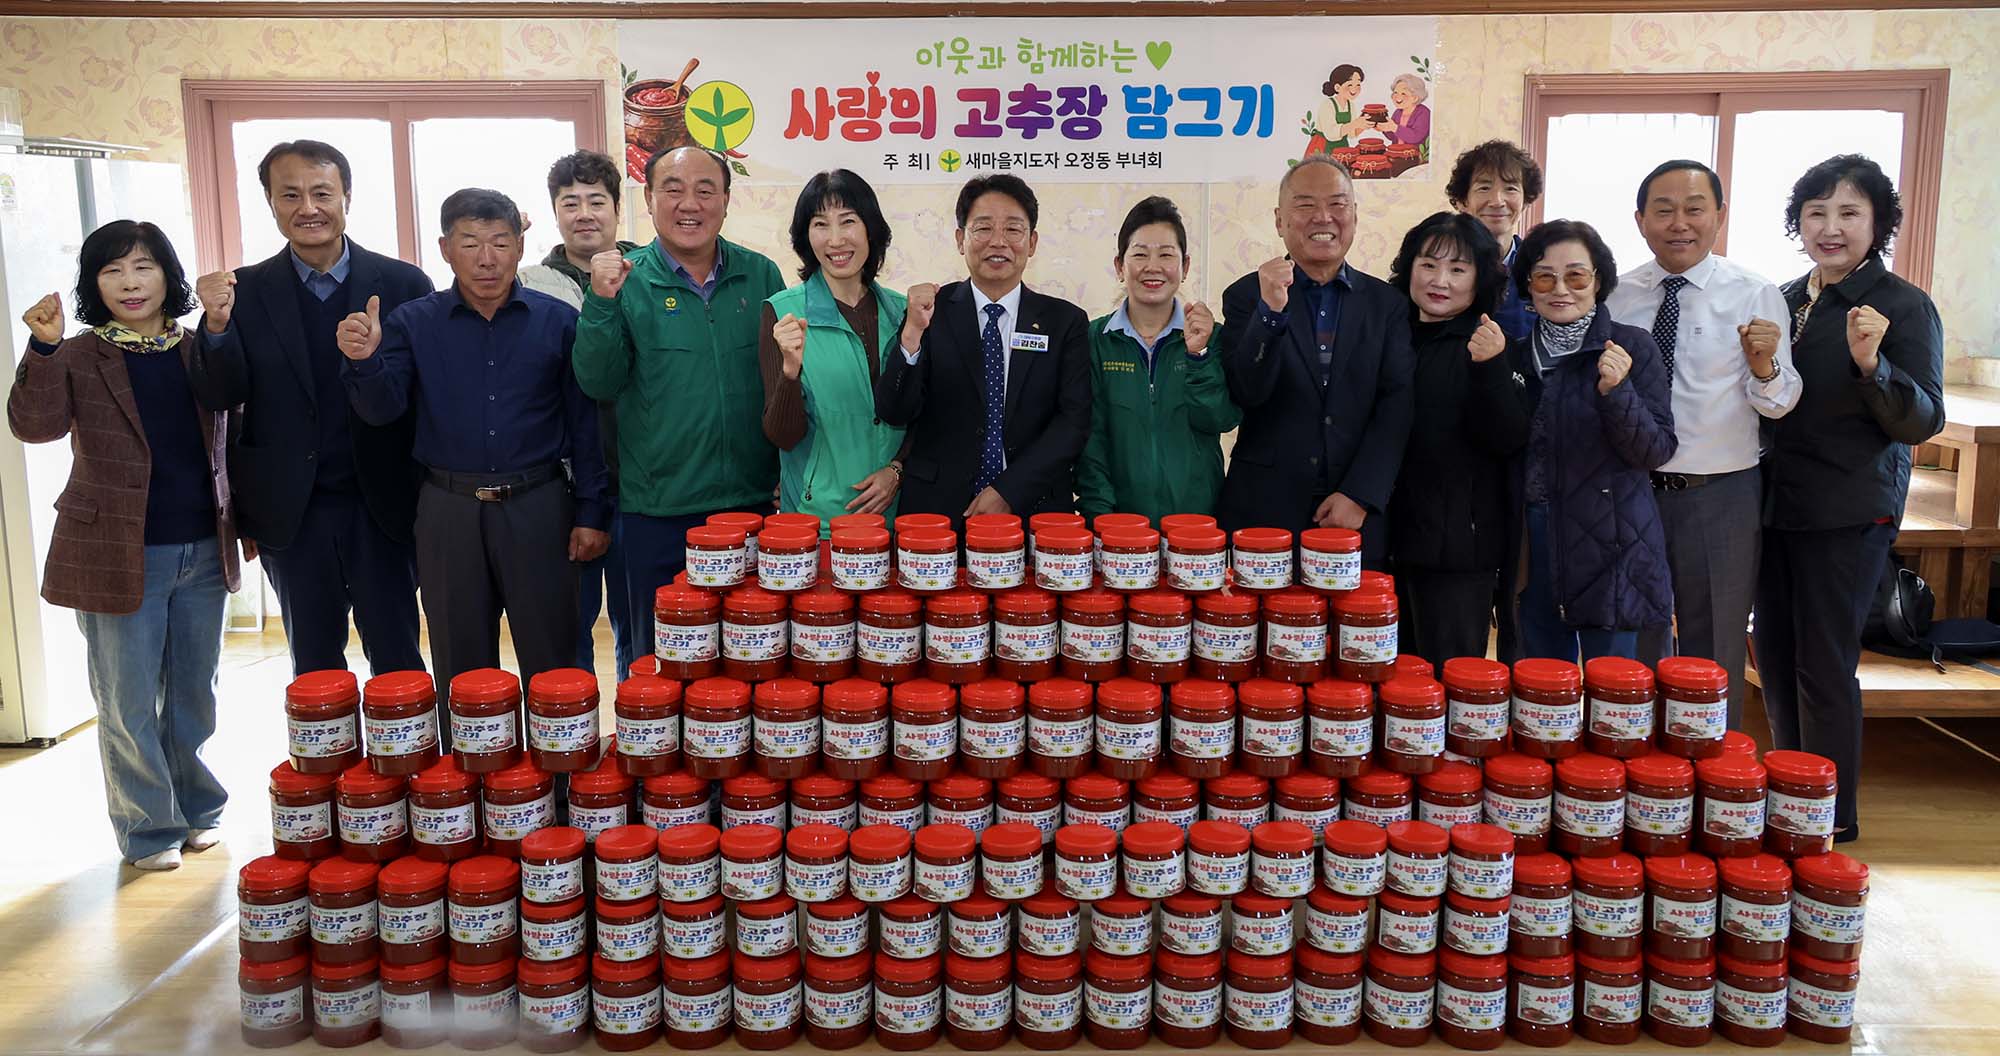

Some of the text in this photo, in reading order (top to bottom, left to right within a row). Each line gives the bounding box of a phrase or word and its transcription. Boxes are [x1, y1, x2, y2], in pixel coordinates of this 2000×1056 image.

[916, 37, 1138, 75] 이웃과 함께하는
[783, 77, 1274, 140] 사랑의 고추장 담그기
[883, 154, 899, 170] 주
[965, 151, 1060, 170] 새마을지도자
[1064, 152, 1111, 169] 오정동
[1115, 152, 1163, 169] 부녀회
